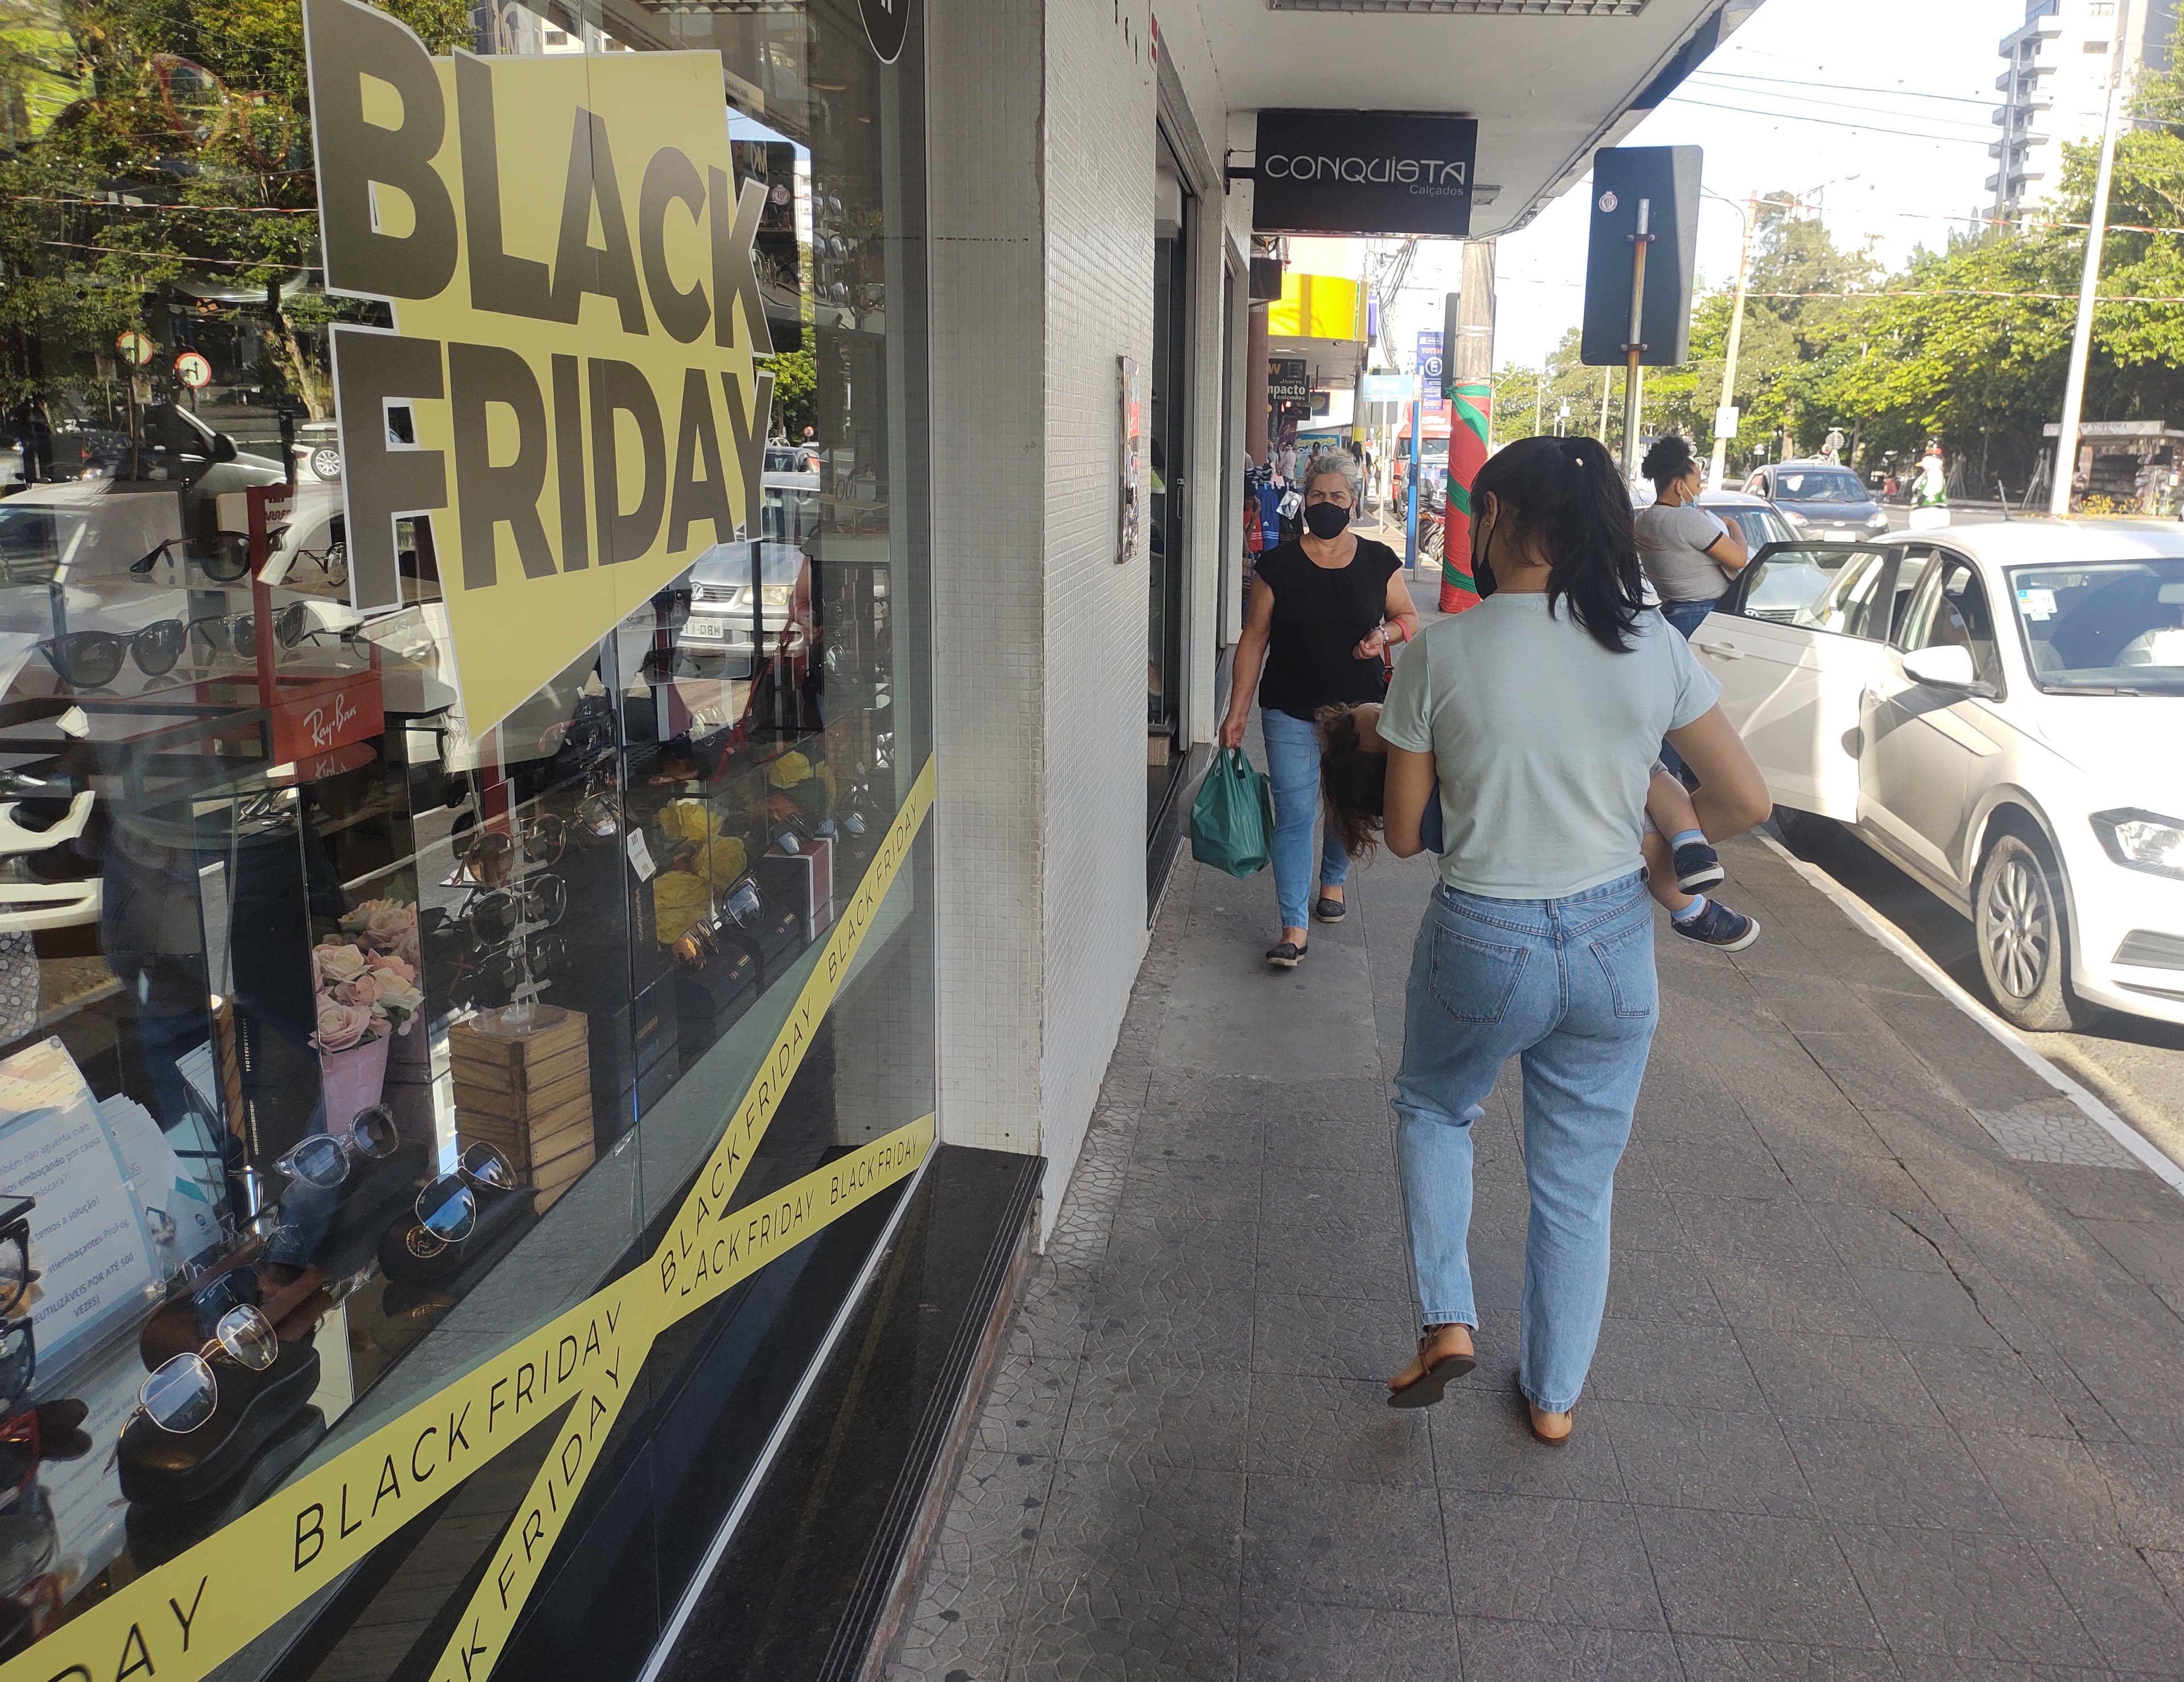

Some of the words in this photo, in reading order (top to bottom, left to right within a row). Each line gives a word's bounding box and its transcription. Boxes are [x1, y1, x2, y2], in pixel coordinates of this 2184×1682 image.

[307, 0, 774, 355] BLACK
[1265, 155, 1466, 185] CONQUISTA
[1409, 184, 1464, 197] Calçados
[1268, 385, 1306, 399] mpacto
[335, 330, 774, 609] FRIDAY
[828, 887, 873, 983] BLACK
[876, 796, 919, 891] FRIDAY
[19, 1156, 65, 1187] embaçando
[65, 1148, 79, 1163] por
[80, 1137, 101, 1152] causa
[40, 1133, 72, 1154] aguenta
[72, 1122, 90, 1138] mais
[661, 1132, 741, 1295] BLACK
[746, 996, 812, 1140] FRIDAY
[34, 1221, 61, 1241] temos
[68, 1195, 100, 1221] solução!
[747, 1189, 814, 1255] FRIDAY
[830, 1155, 875, 1205] BLACK
[877, 1133, 919, 1177] FRIDAY
[34, 1283, 87, 1325] EUTILIZÁVEIS
[87, 1272, 105, 1289] POR
[105, 1260, 120, 1278] ATÉ
[120, 1252, 134, 1268] 500
[73, 1293, 101, 1318] VEZES)
[293, 1400, 471, 1573] BLACK
[497, 1345, 621, 1611] FRIDAY
